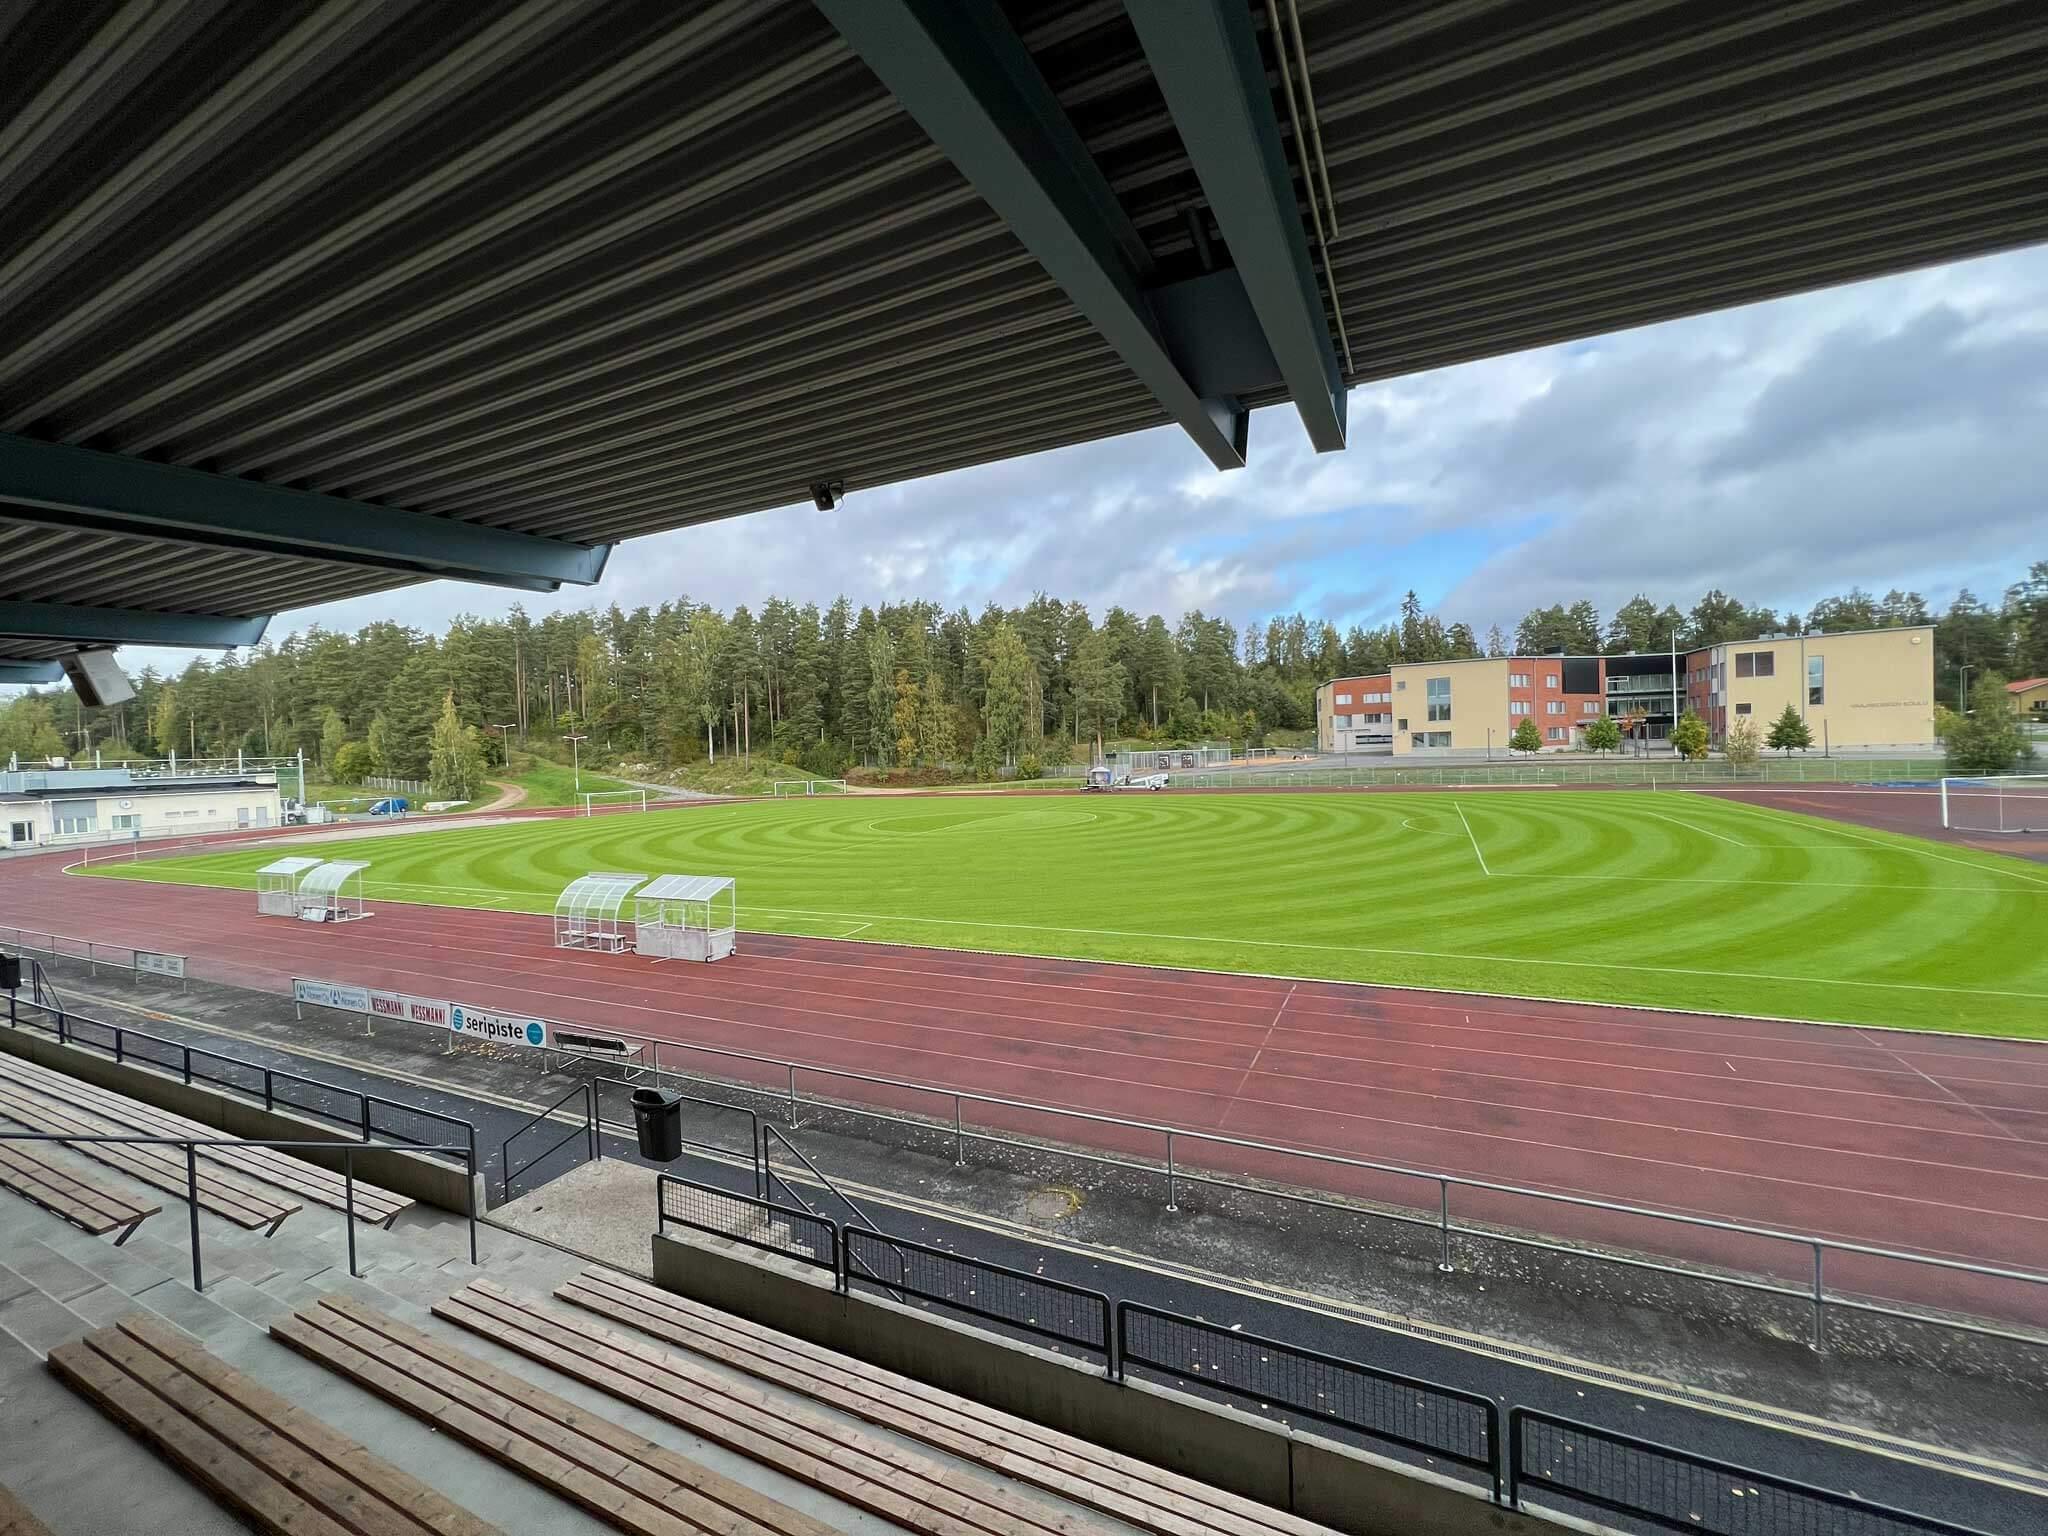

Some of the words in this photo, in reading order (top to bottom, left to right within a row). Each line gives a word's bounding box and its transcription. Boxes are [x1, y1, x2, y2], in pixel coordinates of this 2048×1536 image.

[372, 998, 404, 1016] WESSMANNI
[411, 1004, 445, 1024] WESSMANNI
[466, 1016, 523, 1039] seripiste
